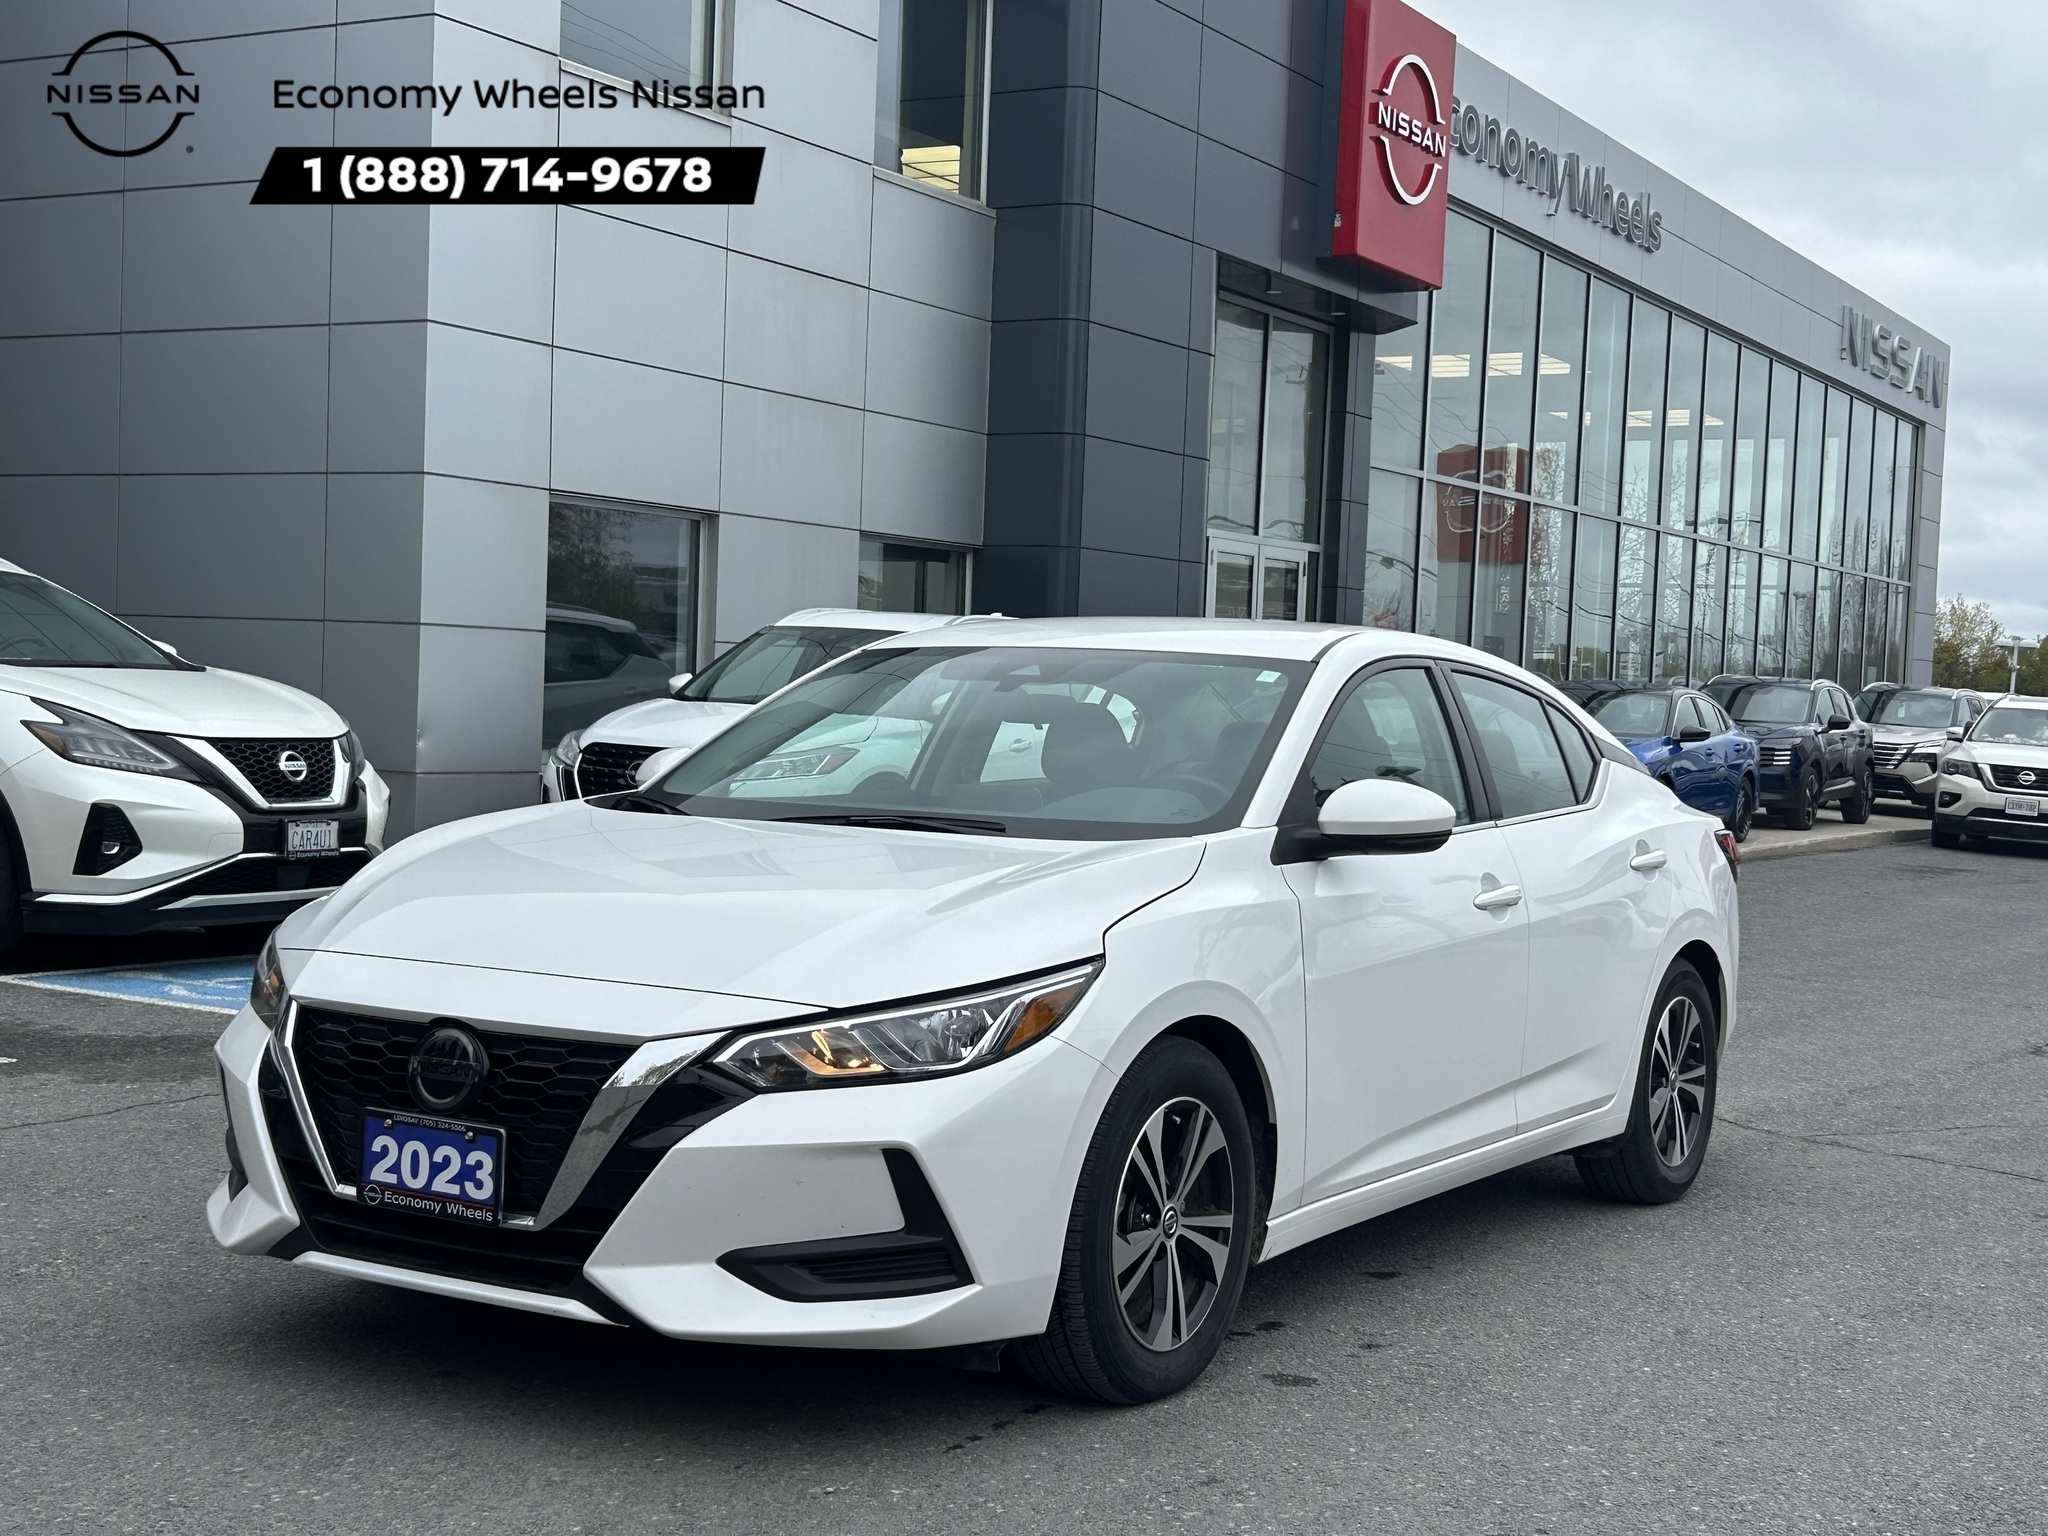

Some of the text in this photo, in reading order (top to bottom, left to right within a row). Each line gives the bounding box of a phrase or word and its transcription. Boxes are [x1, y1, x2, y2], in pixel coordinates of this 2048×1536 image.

[1377, 101, 1446, 157] NISSAN
[1451, 95, 1662, 252] conomy Wheels
[1840, 305, 1946, 409] NISSAN
[370, 1135, 494, 1200] 2023
[384, 1190, 493, 1221] Economy Wheels
